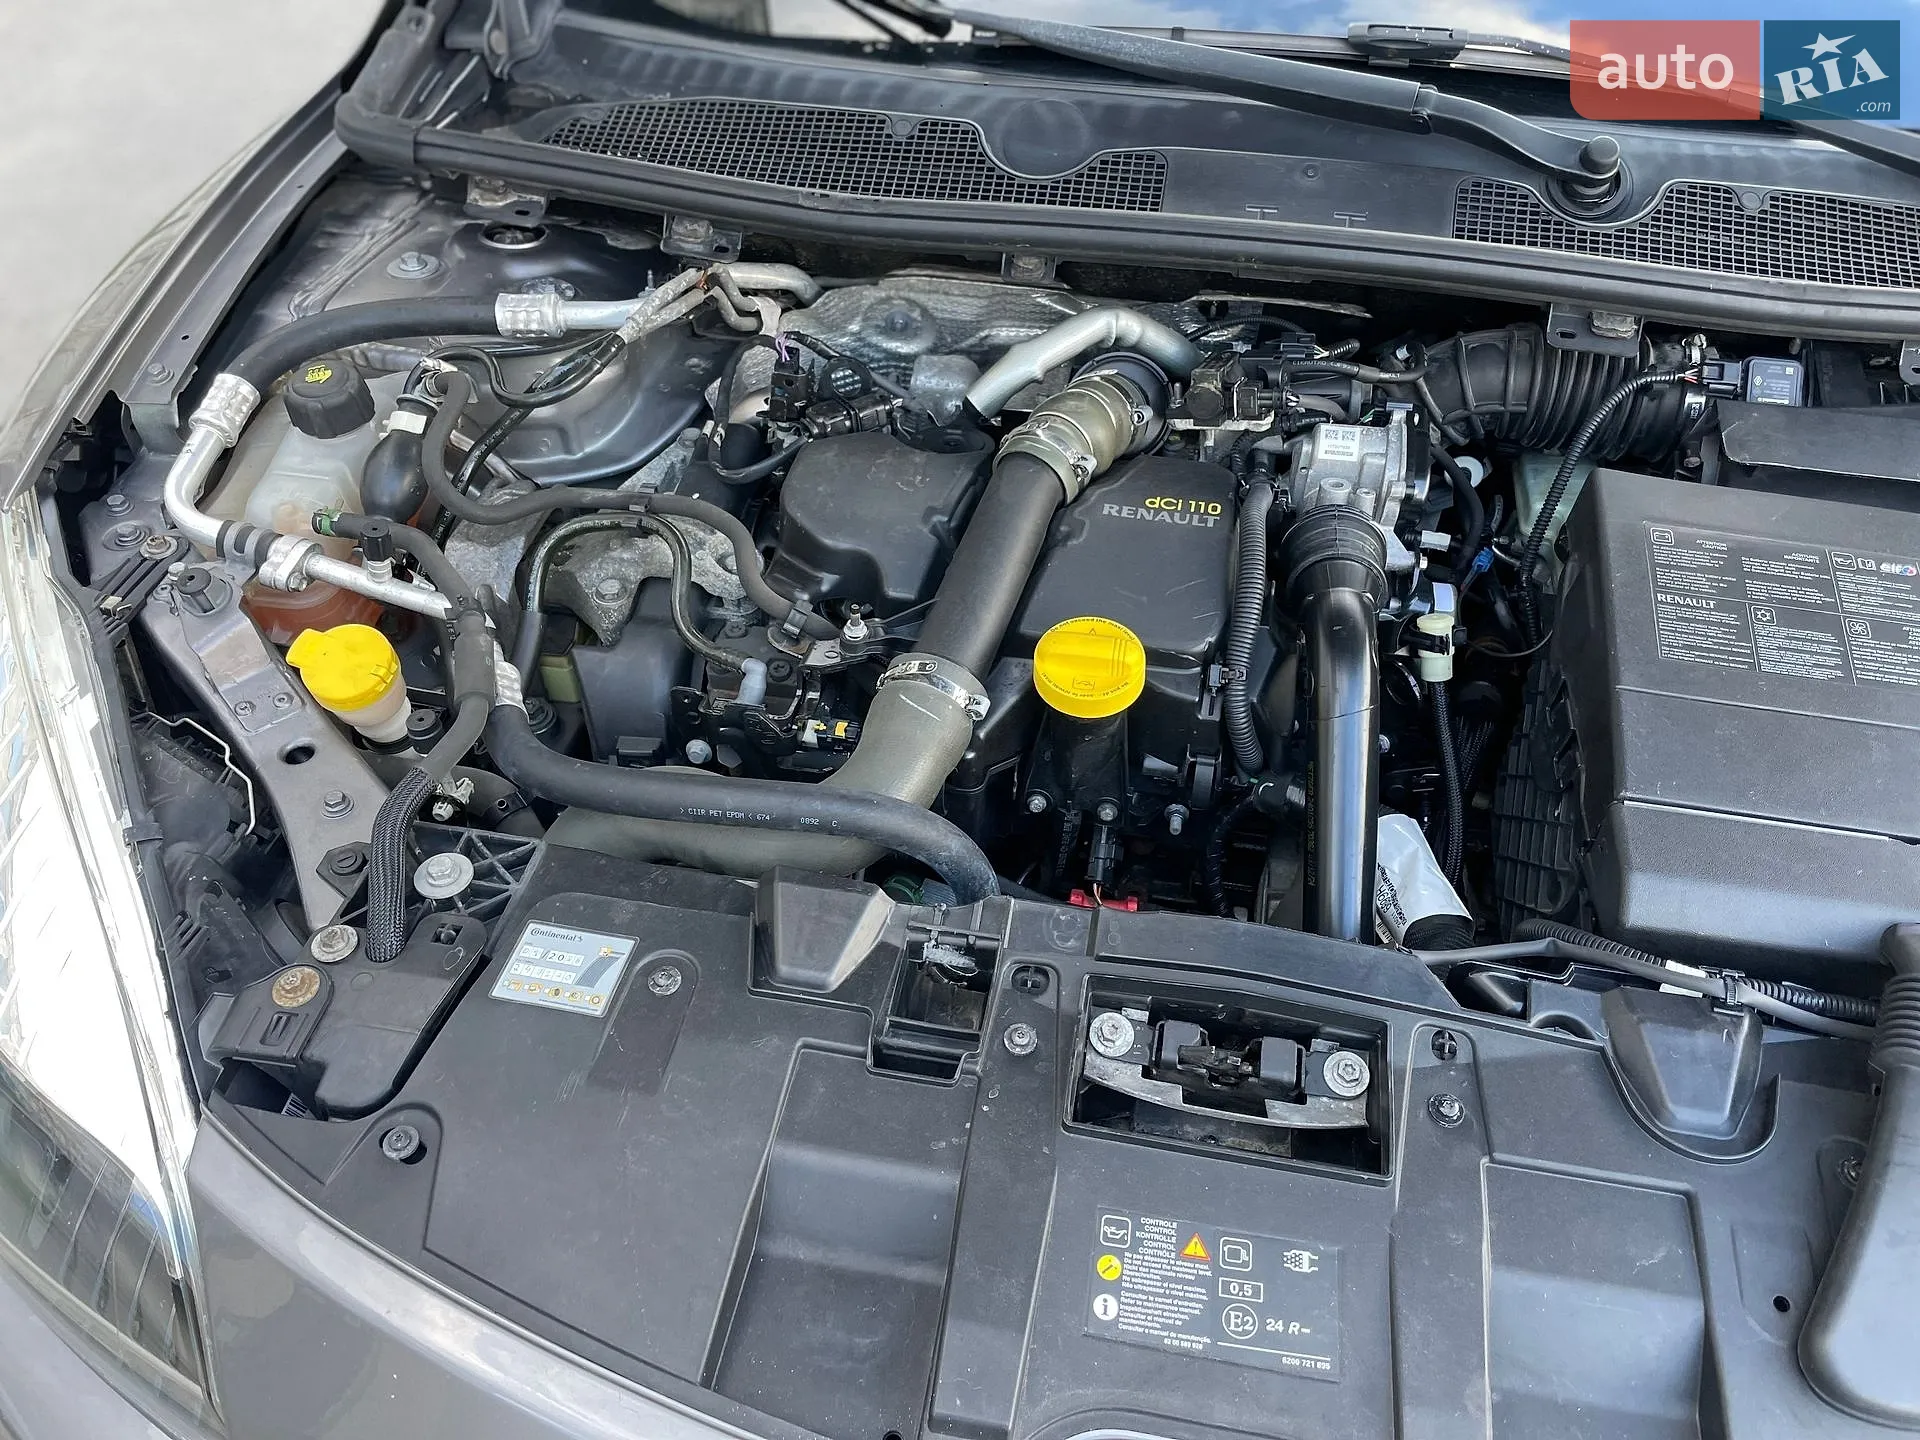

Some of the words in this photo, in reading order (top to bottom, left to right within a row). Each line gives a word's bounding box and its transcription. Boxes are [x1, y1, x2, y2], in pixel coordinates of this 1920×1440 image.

[1145, 497, 1183, 511] dCi
[1189, 500, 1221, 515] 110
[1102, 503, 1220, 527] RENAULT
[1657, 593, 1716, 608] RENAULT
[530, 928, 576, 941] Continental
[1140, 1217, 1177, 1229] CONTROLE
[1135, 1231, 1177, 1243] KONTROLLE
[1144, 1225, 1177, 1236] CONTROL
[1143, 1240, 1176, 1251] CONTROL
[1230, 1283, 1252, 1296] 0,5
[1228, 1311, 1254, 1331] E2
[1266, 1319, 1284, 1332] 24
